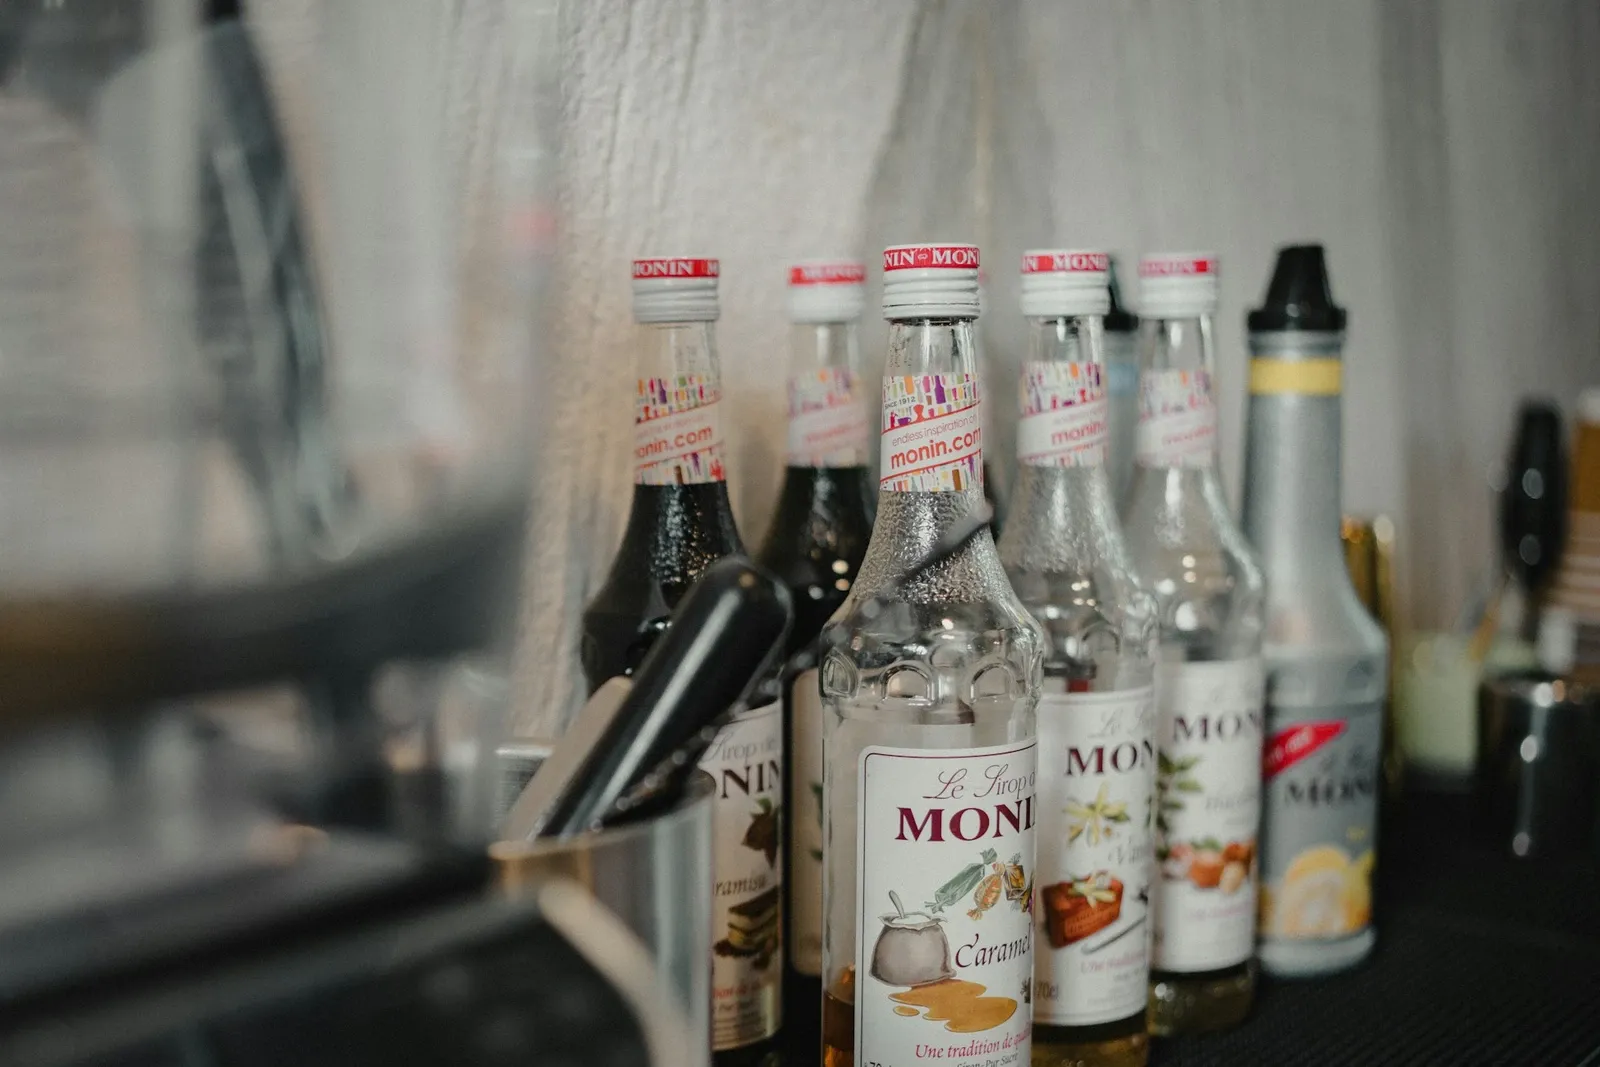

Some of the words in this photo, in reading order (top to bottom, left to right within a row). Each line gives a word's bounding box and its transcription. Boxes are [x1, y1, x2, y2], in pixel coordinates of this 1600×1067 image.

[899, 396, 915, 405] 1912
[892, 430, 923, 447] endless
[924, 418, 968, 437] inspiration
[721, 759, 780, 798] NIN
[922, 768, 967, 799] Le
[973, 764, 1026, 800] Sirop
[894, 795, 1036, 842] MONI
[955, 922, 1032, 968] Caramel
[915, 1044, 944, 1058] Une
[947, 1039, 1000, 1058] tradition
[1002, 1032, 1013, 1049] de
